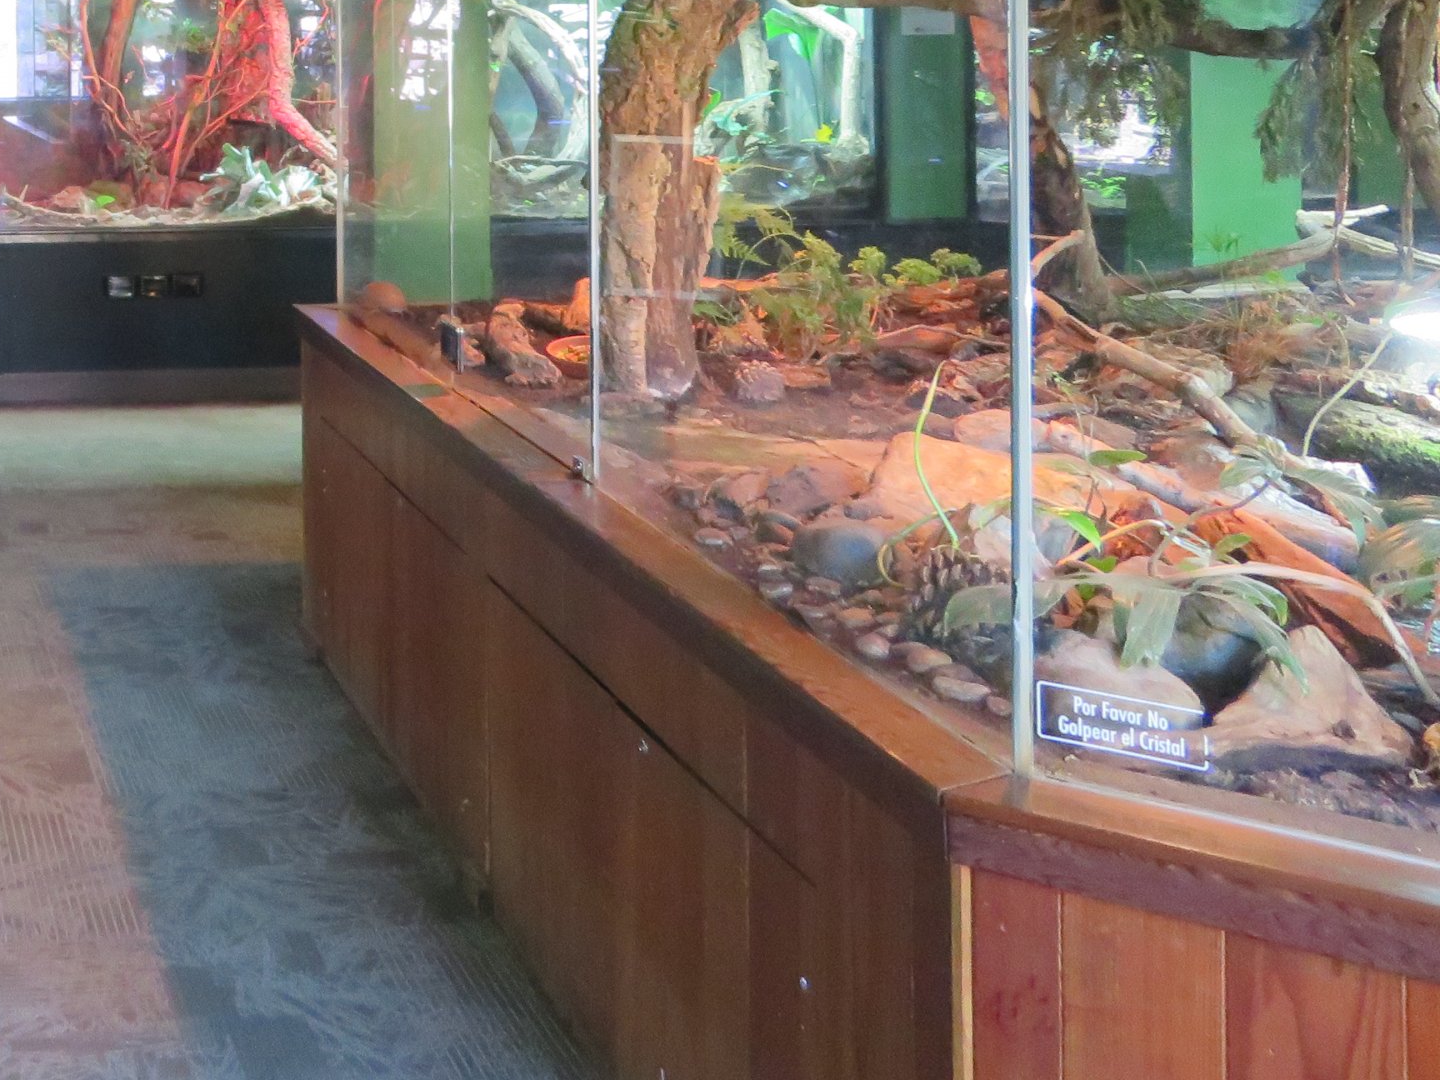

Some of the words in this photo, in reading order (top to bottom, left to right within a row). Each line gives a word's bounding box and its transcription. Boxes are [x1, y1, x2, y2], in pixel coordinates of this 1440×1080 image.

[1073, 696, 1097, 717] Por
[1102, 702, 1143, 724] Favor
[1148, 710, 1169, 731] No
[1058, 715, 1117, 743] Golpear
[1122, 728, 1135, 747] el
[1139, 732, 1186, 757] Cristal
